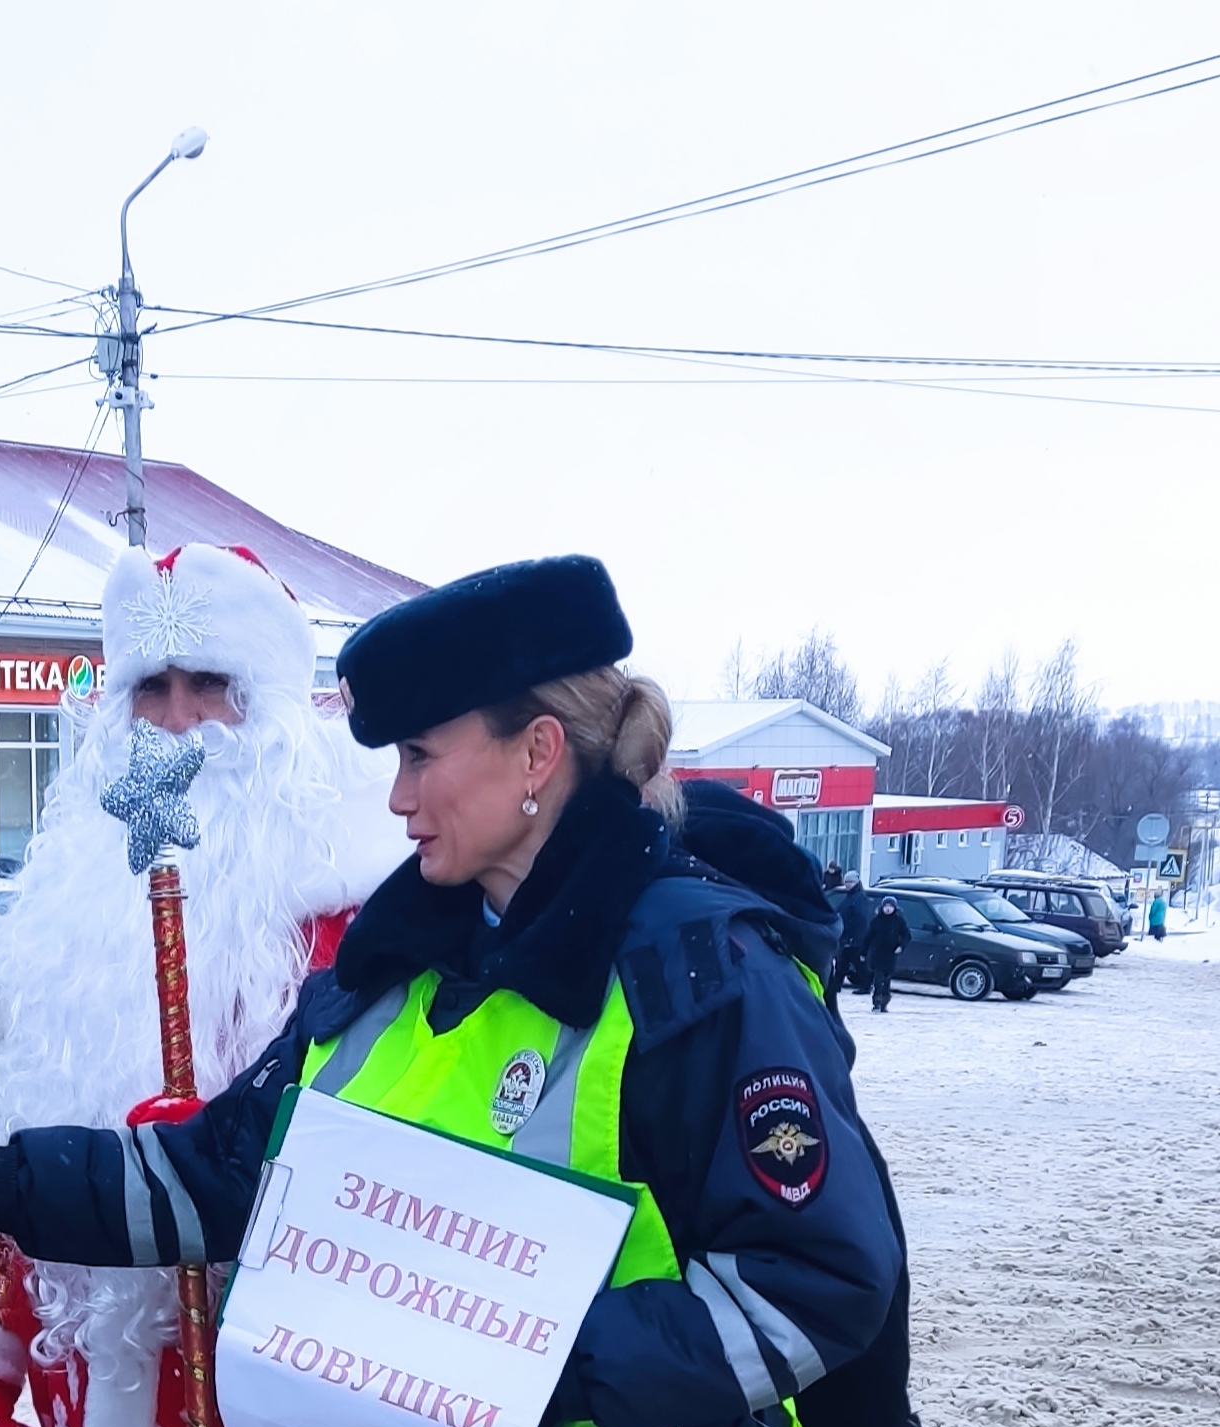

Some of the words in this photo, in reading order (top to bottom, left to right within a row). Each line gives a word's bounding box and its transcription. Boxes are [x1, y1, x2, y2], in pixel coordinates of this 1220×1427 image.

[743, 1074, 807, 1100] ПОЛИЦИЯ
[750, 1098, 810, 1128] РОССИЯ
[780, 1181, 810, 1202] МВД
[335, 1172, 547, 1278] ЗИМНИЕ
[267, 1224, 559, 1355] ДОРОЖНЫЕ
